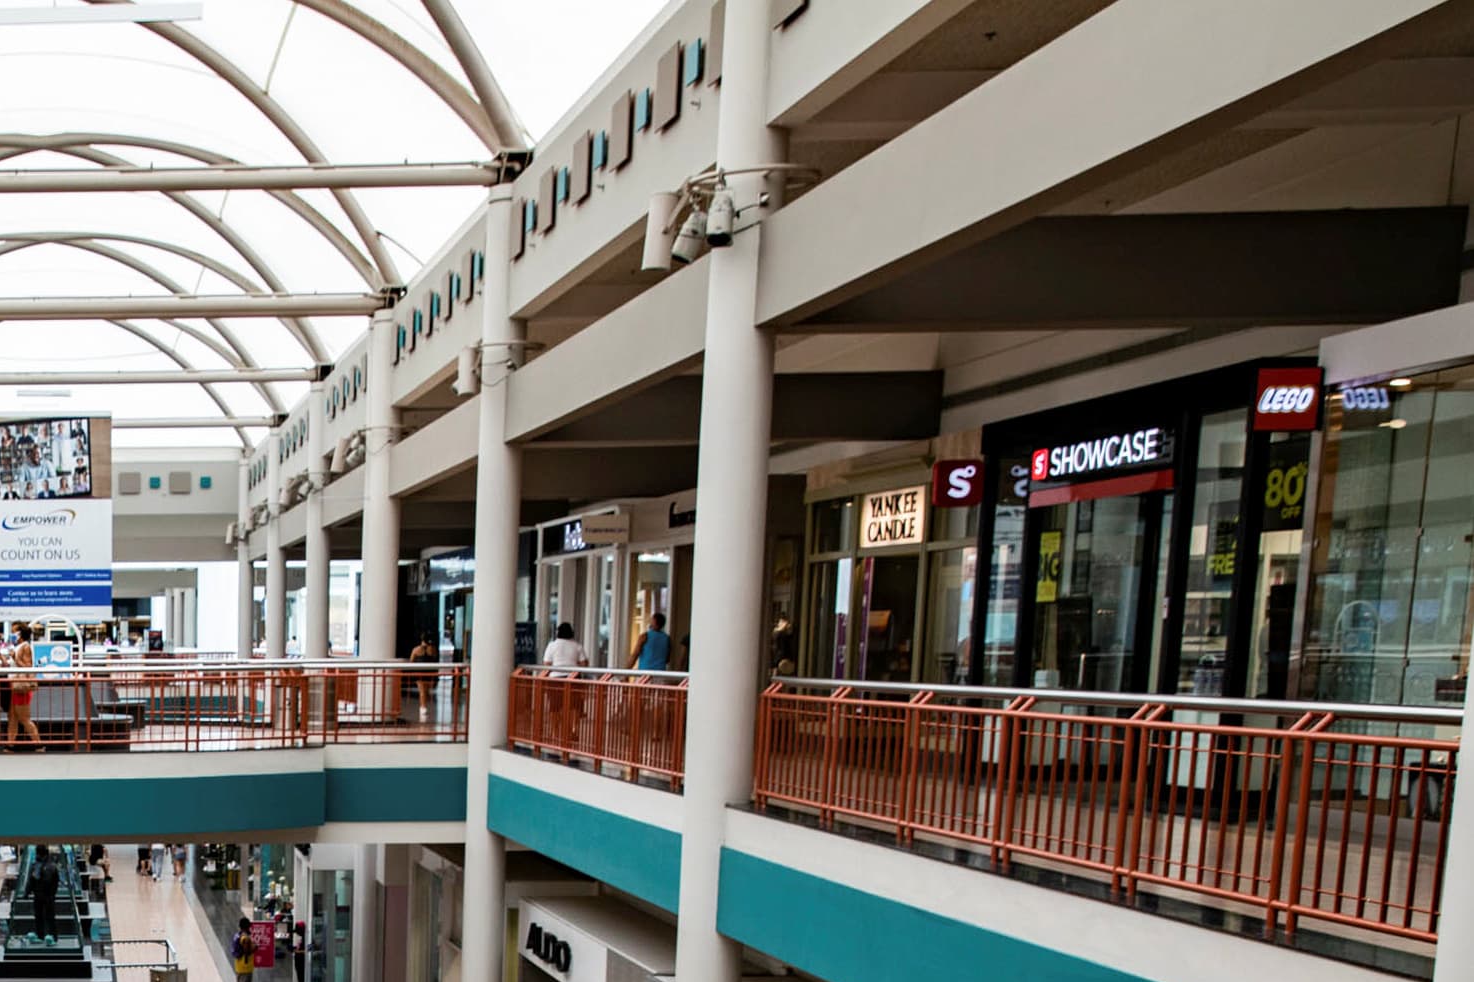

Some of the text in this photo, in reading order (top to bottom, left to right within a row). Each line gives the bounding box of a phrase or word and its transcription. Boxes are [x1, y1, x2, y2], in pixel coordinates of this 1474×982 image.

[1257, 386, 1316, 414] LEGO
[1049, 427, 1159, 477] SHOWCASE
[870, 490, 918, 518] YANKEE
[12, 515, 67, 526] EMPOWER
[867, 517, 916, 543] CANDLE
[0, 549, 81, 561] COUNT ON US
[18, 537, 63, 547] YOU CAN
[1206, 553, 1235, 577] FRE
[526, 922, 572, 973] ALDO
